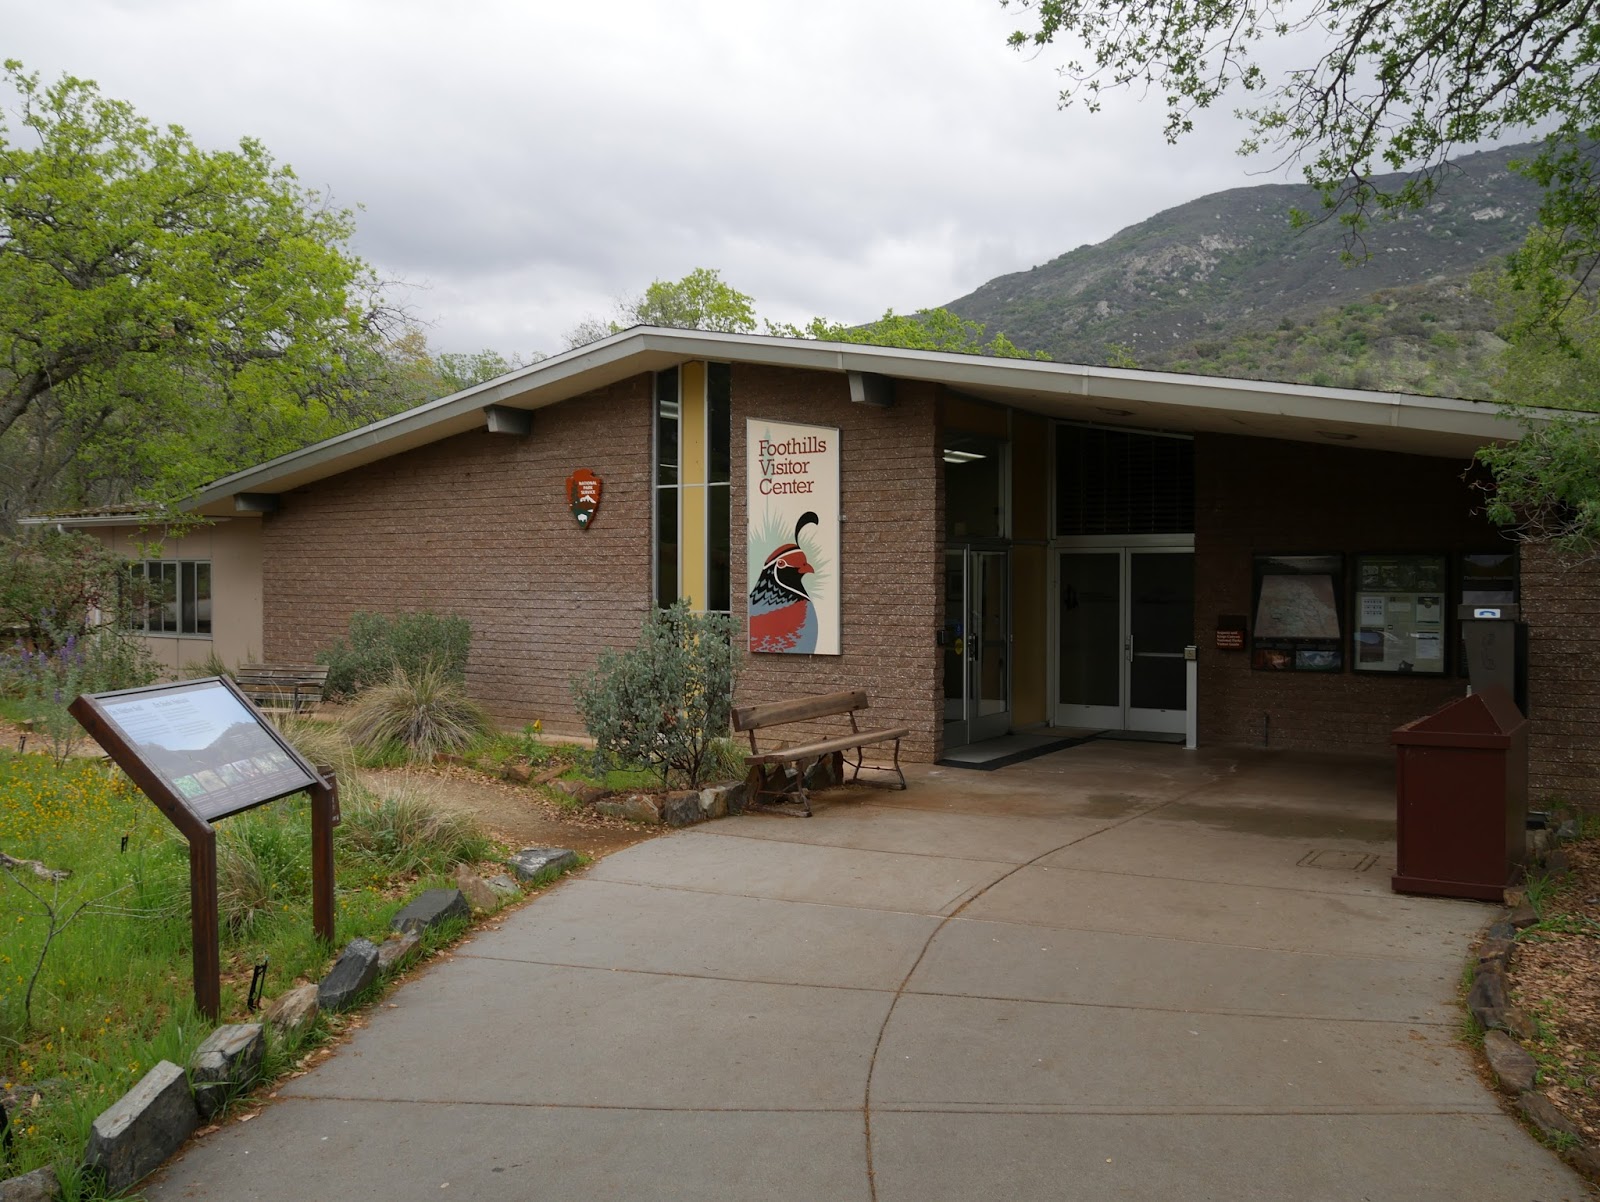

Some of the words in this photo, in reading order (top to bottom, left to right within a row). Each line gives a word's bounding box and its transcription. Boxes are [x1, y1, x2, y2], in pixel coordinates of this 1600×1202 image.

[759, 436, 827, 456] Foothills
[759, 458, 810, 476] Visitor
[759, 478, 815, 495] Center
